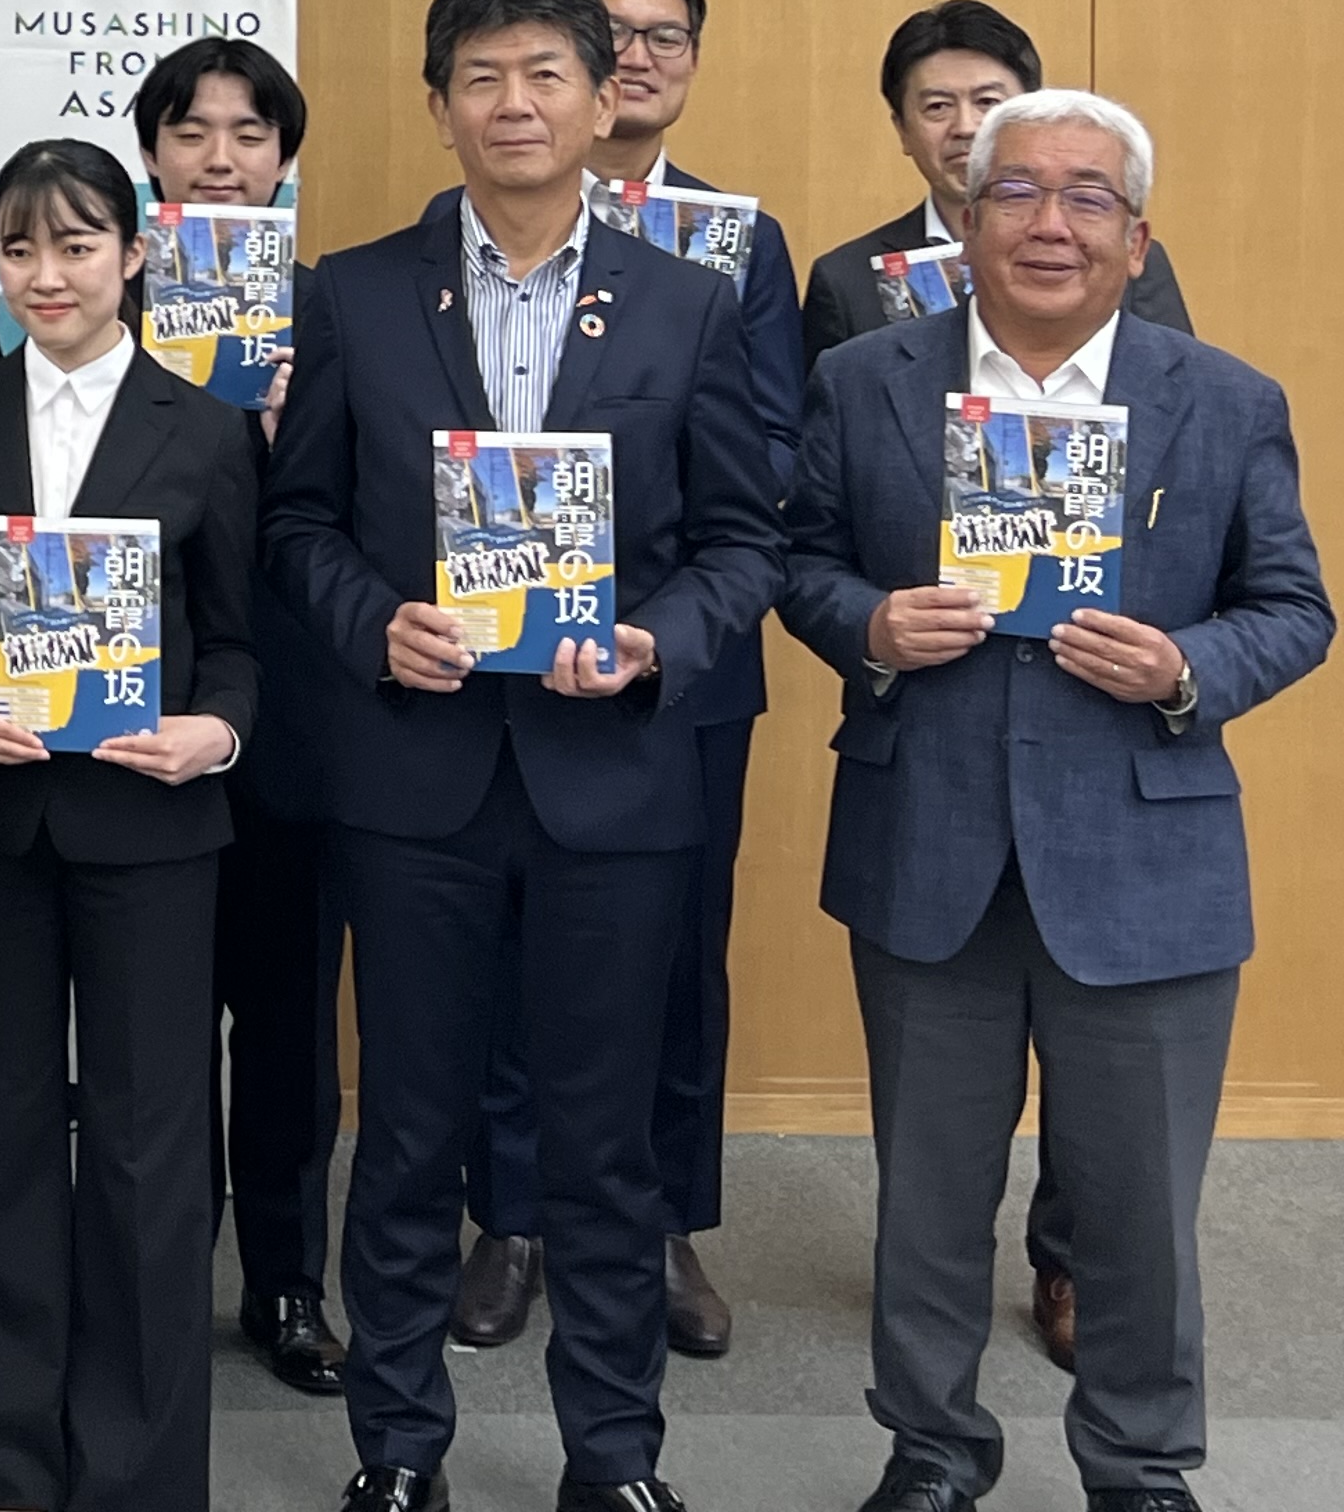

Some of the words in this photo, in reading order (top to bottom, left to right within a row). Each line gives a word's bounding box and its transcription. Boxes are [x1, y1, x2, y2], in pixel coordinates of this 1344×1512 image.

[14, 11, 261, 37] MUSASHINO
[69, 51, 162, 76] FRO
[552, 460, 600, 626] 朝霞の坂
[1057, 431, 1110, 597] 朝霞の坂
[103, 546, 145, 707] 朝霞の坂
